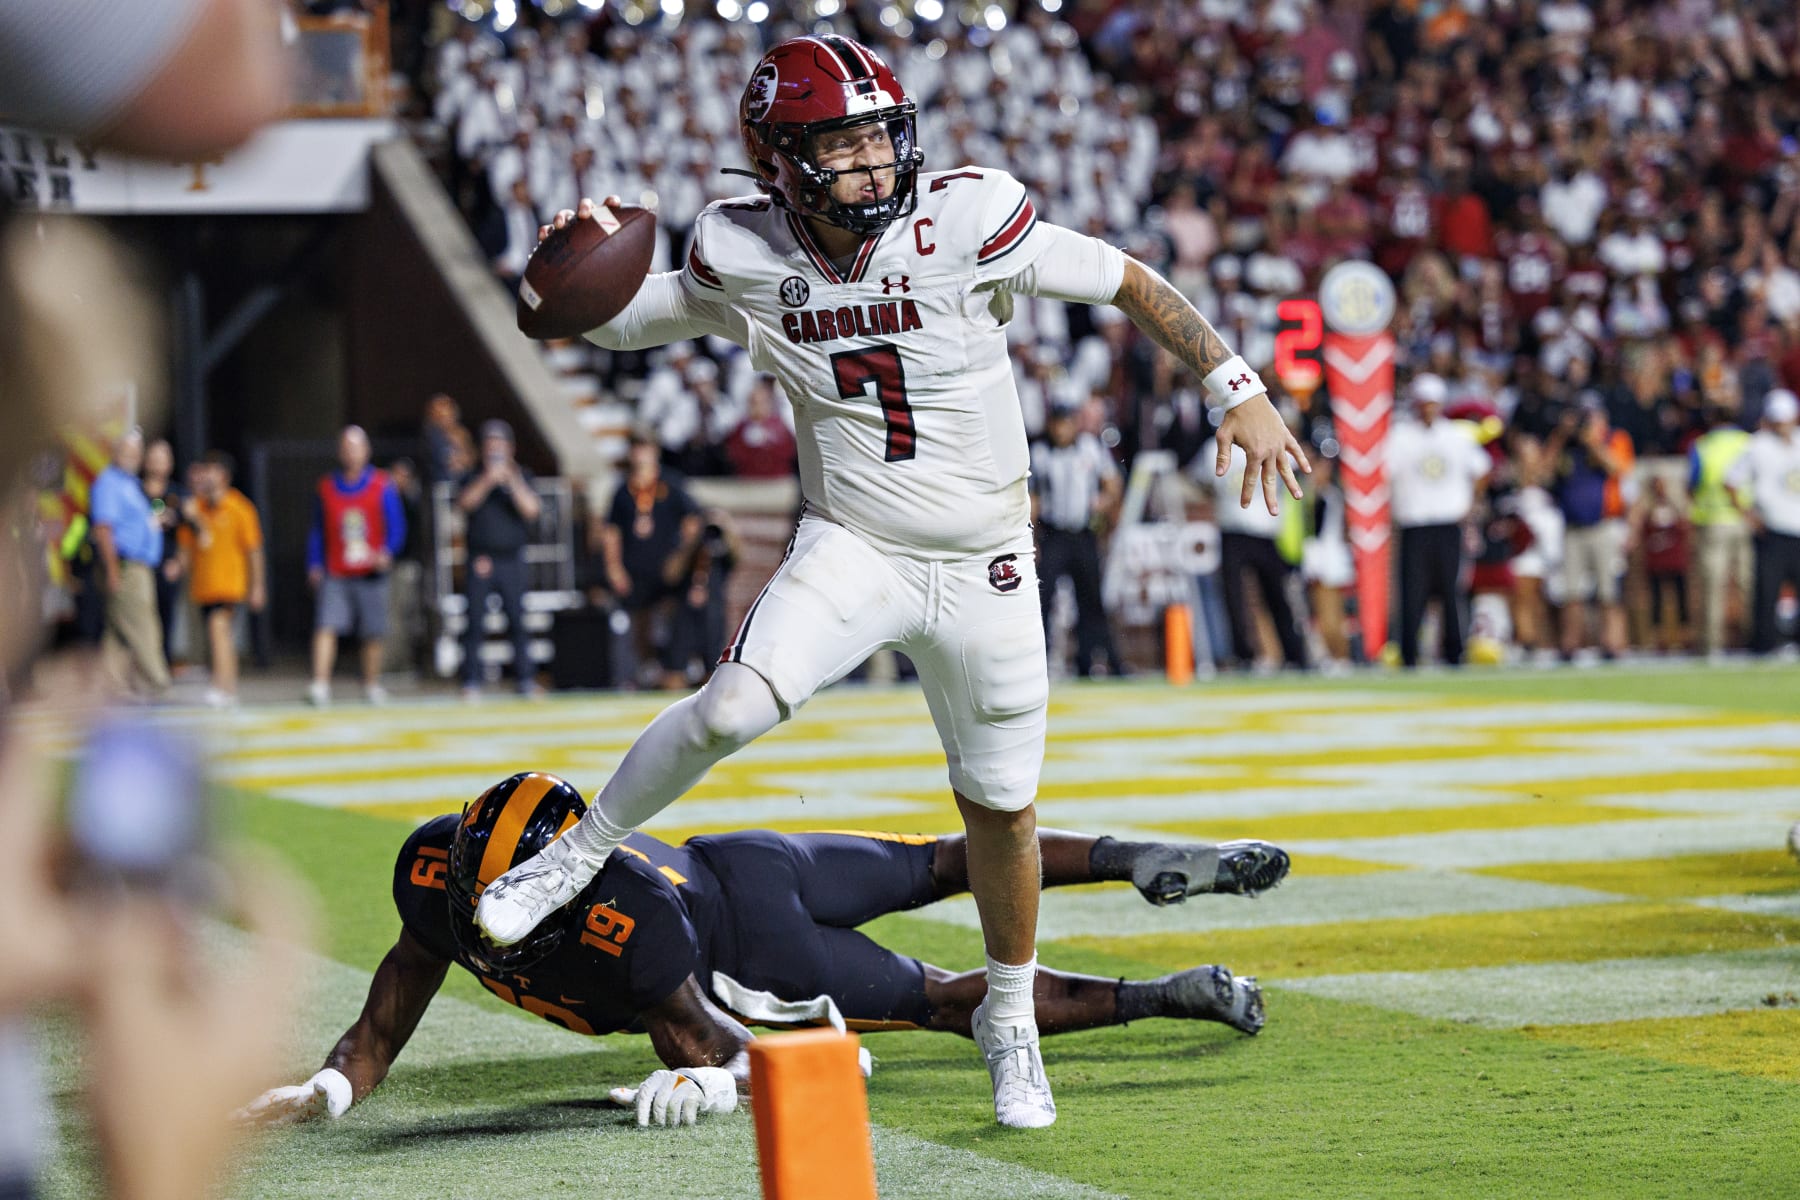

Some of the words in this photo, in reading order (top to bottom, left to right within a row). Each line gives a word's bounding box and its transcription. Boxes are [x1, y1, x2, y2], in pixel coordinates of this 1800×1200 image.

[913, 217, 936, 256] C
[782, 278, 809, 305] SEC
[781, 299, 923, 344] CAROLINA
[1274, 299, 1323, 378] 2
[829, 343, 917, 463] 7
[580, 903, 635, 958] 19
